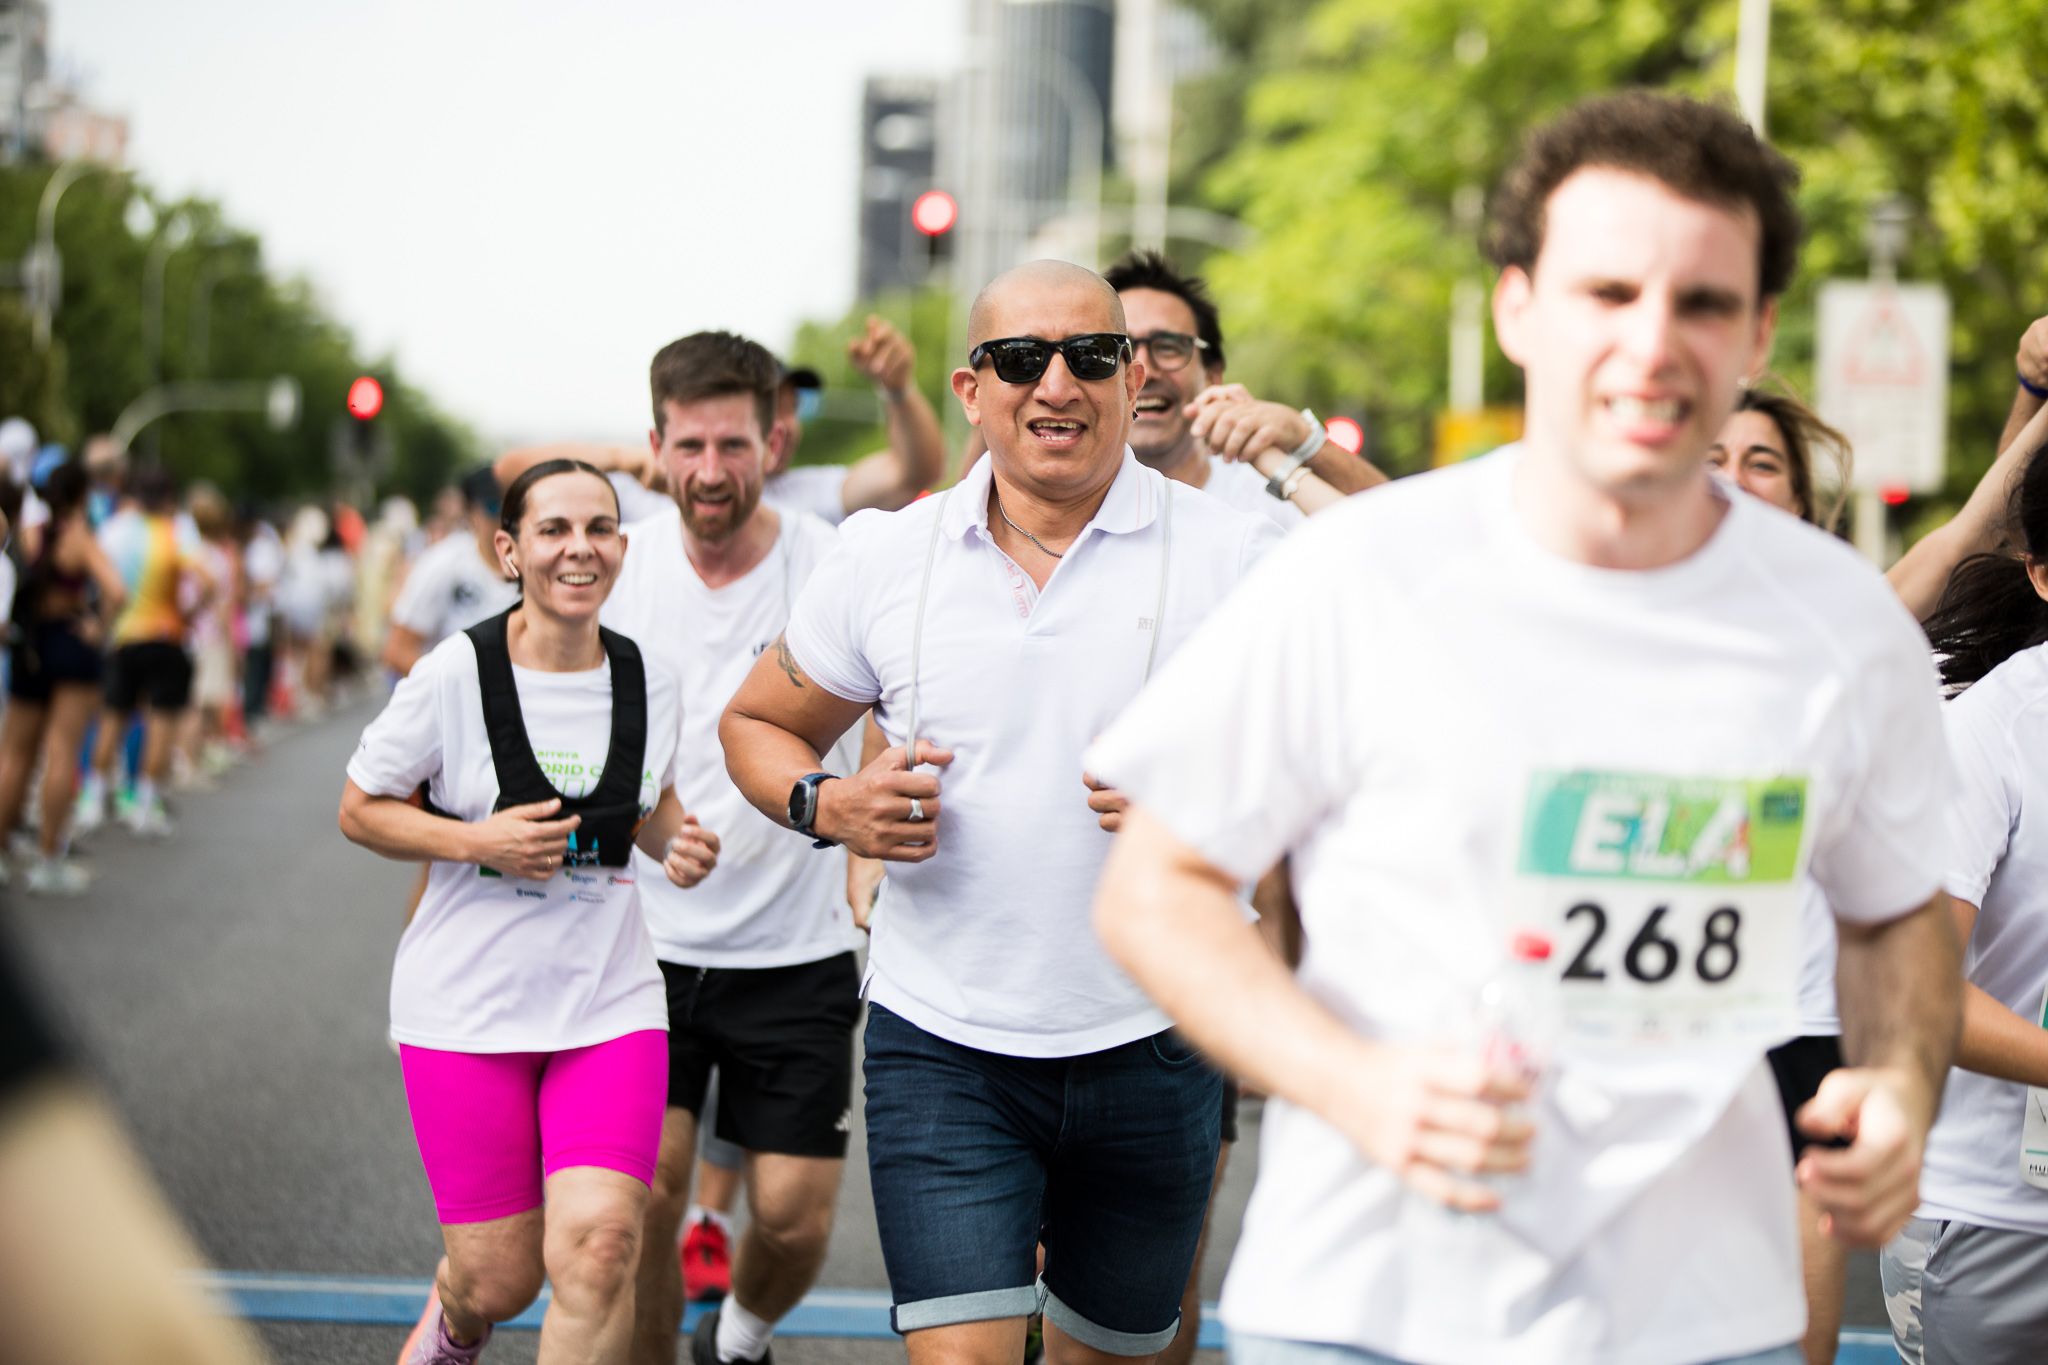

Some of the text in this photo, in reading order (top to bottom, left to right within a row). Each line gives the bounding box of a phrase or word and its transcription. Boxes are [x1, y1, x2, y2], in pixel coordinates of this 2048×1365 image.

[536, 750, 579, 760] arrera
[540, 762, 585, 776] DRID
[1567, 790, 1750, 879] ELA
[1560, 902, 1741, 983] 268
